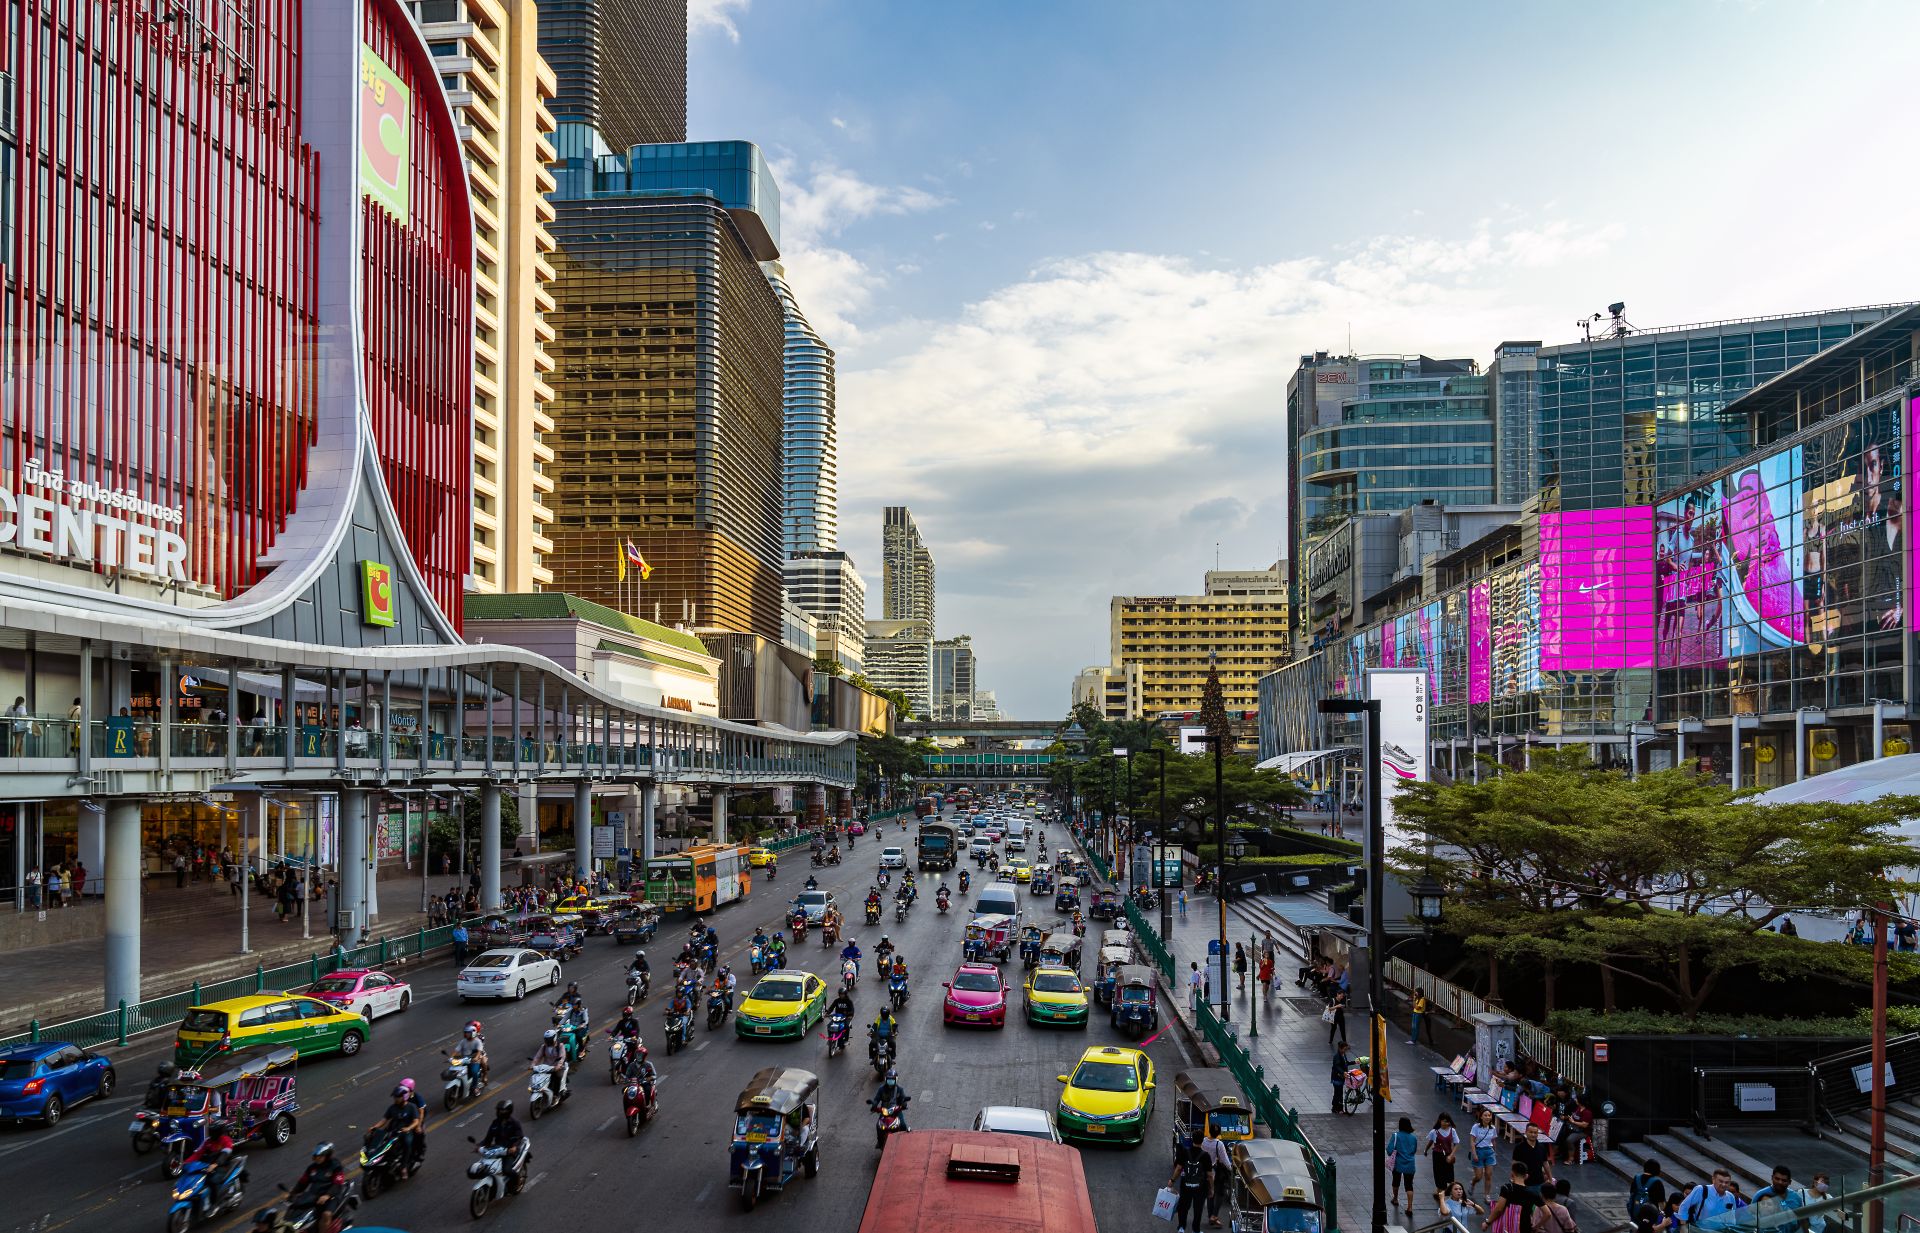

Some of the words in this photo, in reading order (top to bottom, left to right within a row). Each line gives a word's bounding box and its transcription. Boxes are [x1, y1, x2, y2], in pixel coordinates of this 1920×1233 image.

[1317, 373, 1347, 383] ZEN
[24, 458, 63, 492] บิ๊กซี
[390, 714, 416, 726] Montra
[115, 730, 126, 749] R
[308, 735, 316, 750] R
[239, 1079, 278, 1098] VIP
[1288, 1188, 1303, 1196] TAXI
